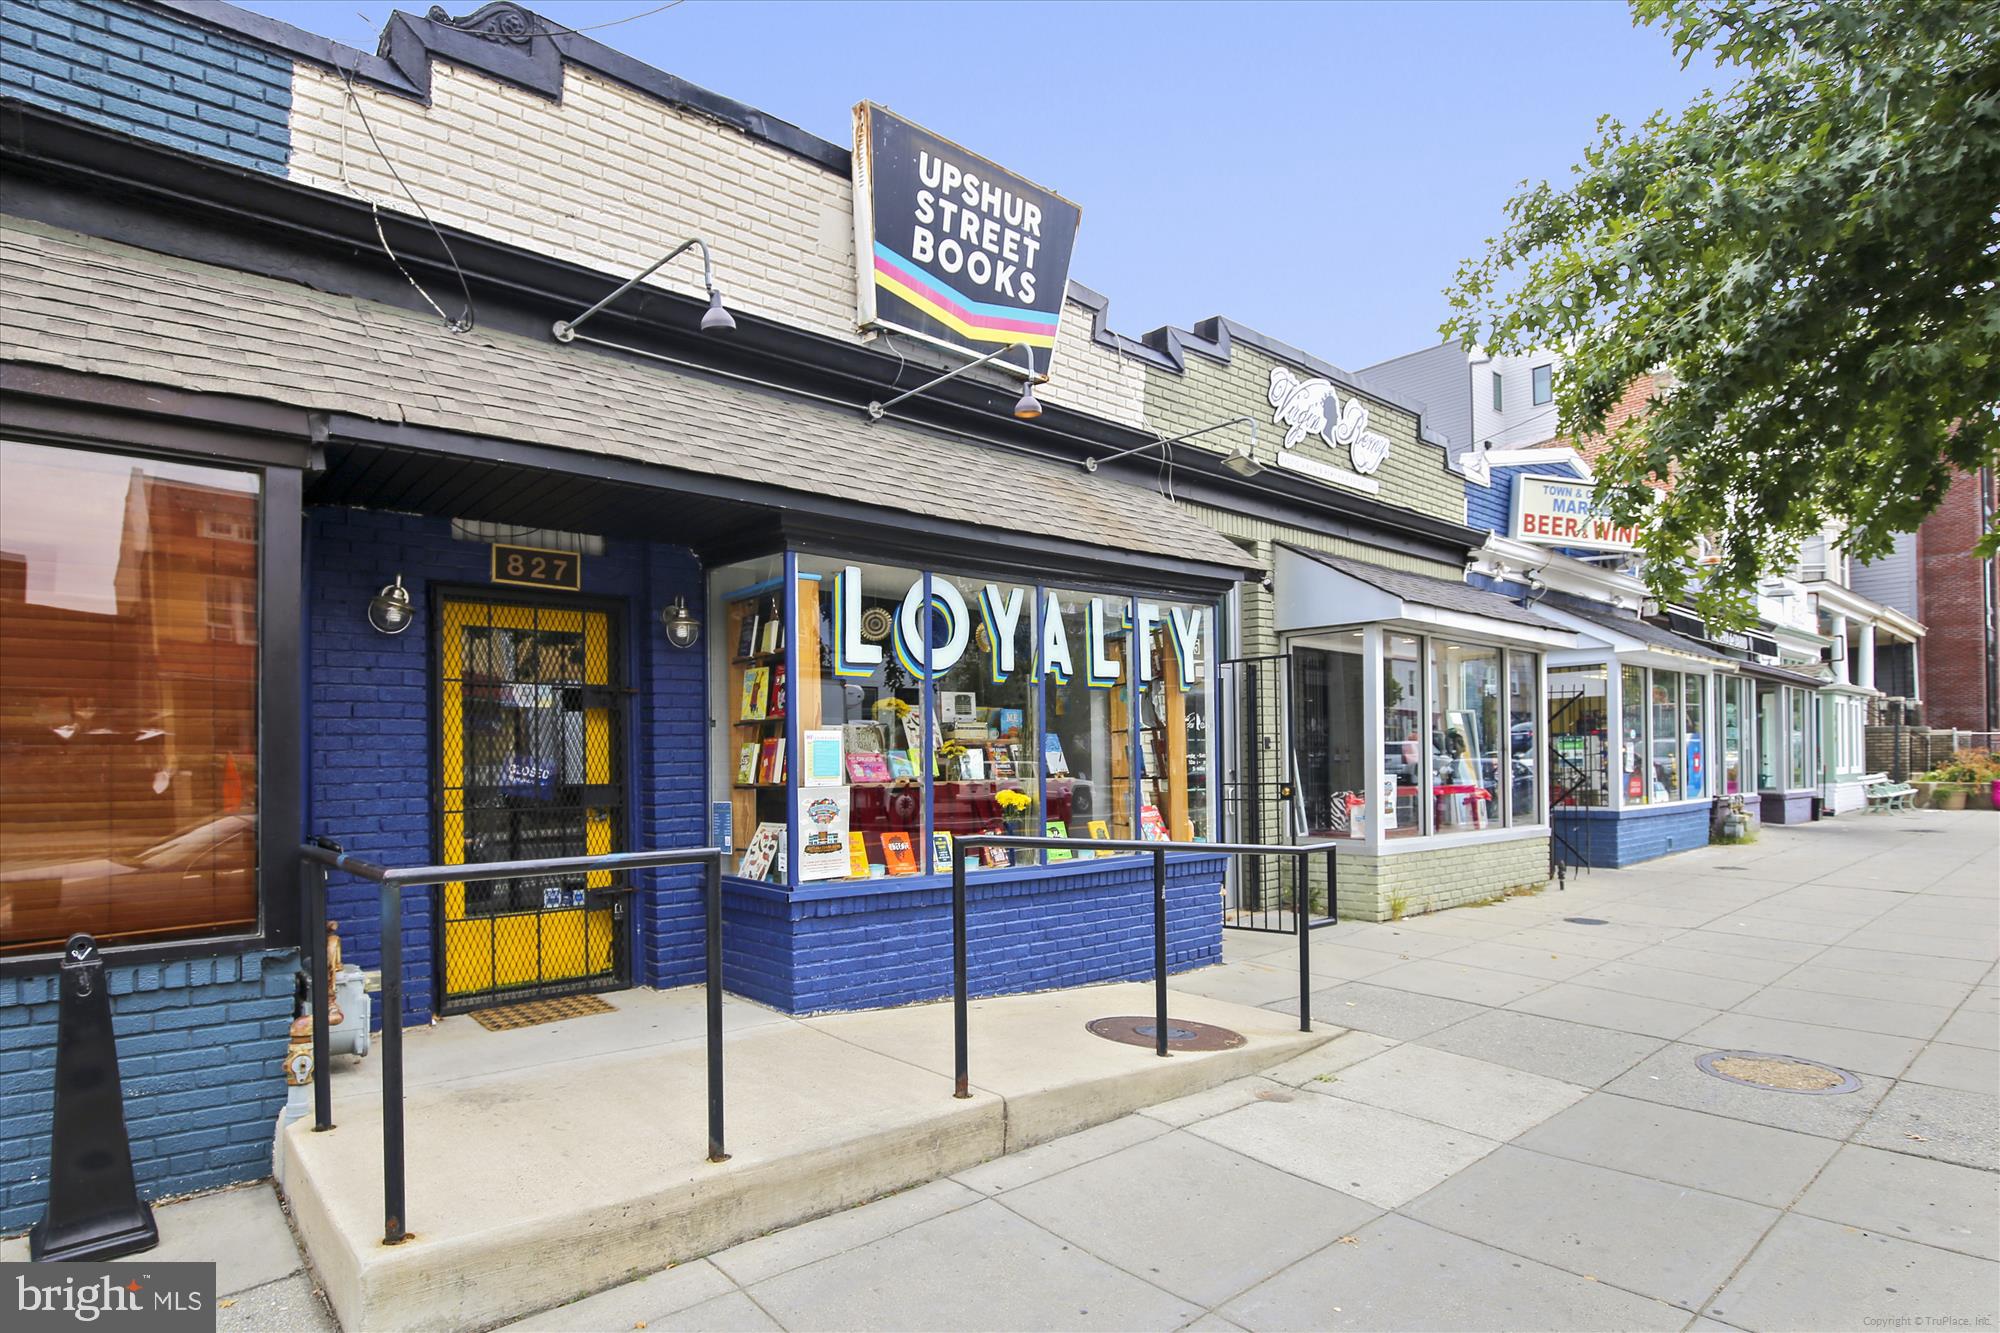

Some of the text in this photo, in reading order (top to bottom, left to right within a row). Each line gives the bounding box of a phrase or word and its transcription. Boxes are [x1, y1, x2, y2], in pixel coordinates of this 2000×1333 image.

[914, 189, 1040, 269] STREET
[919, 151, 1042, 237] UPSHUR
[911, 225, 1036, 304] BOOKS
[1523, 513, 1578, 538] BEER
[1582, 528, 1588, 539] &
[1543, 485, 1573, 497] TOWN
[1575, 489, 1582, 498] &
[506, 553, 568, 581] 827
[833, 565, 1202, 692] LOYALTY
